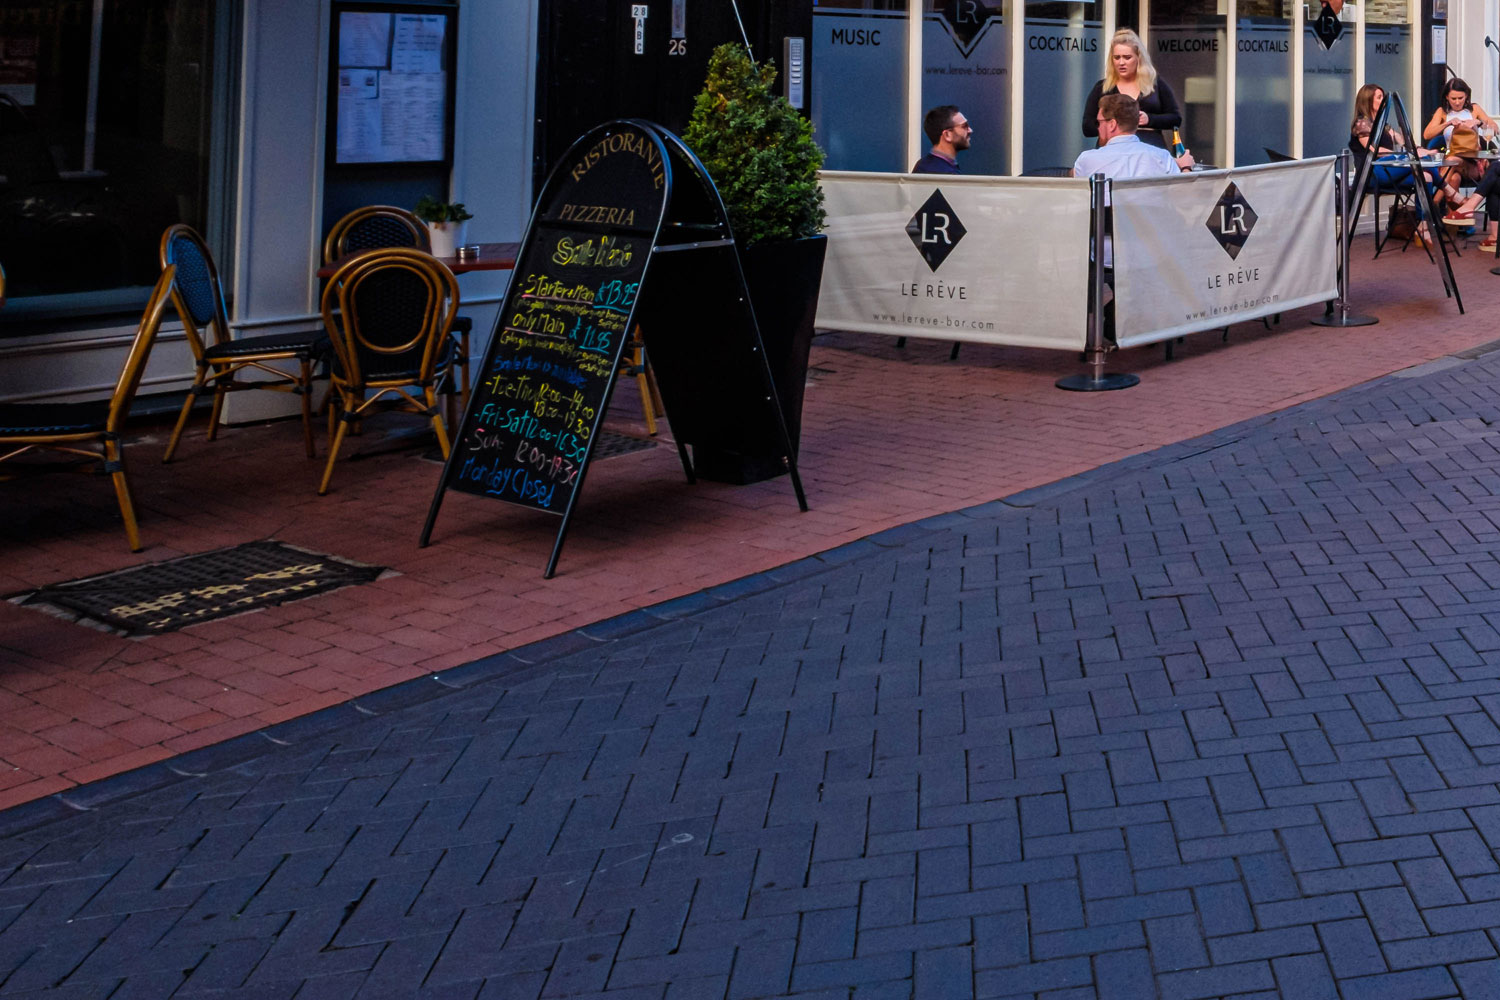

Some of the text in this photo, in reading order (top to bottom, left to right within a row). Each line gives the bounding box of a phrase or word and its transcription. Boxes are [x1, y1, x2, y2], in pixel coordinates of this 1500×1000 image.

[633, 6, 646, 16] 28
[831, 28, 881, 46] MUSIC
[1028, 35, 1098, 52] COCKTAILS
[1157, 38, 1219, 52] WELCOME
[1237, 39, 1289, 53] COCKTAILS
[669, 39, 687, 56] 26
[1375, 43, 1400, 55] MUSIC
[925, 62, 1008, 76] www.lereve-bar.com
[571, 132, 665, 190] RISTORANTE
[558, 203, 635, 226] PIZZERIA
[1207, 266, 1260, 289] LE RÊVE
[901, 279, 967, 300] LE RÊVE
[1185, 293, 1279, 321] www.lereve-bar.com
[872, 311, 995, 331] www.lereve-bar.com
[459, 456, 557, 508] Monday Closed
